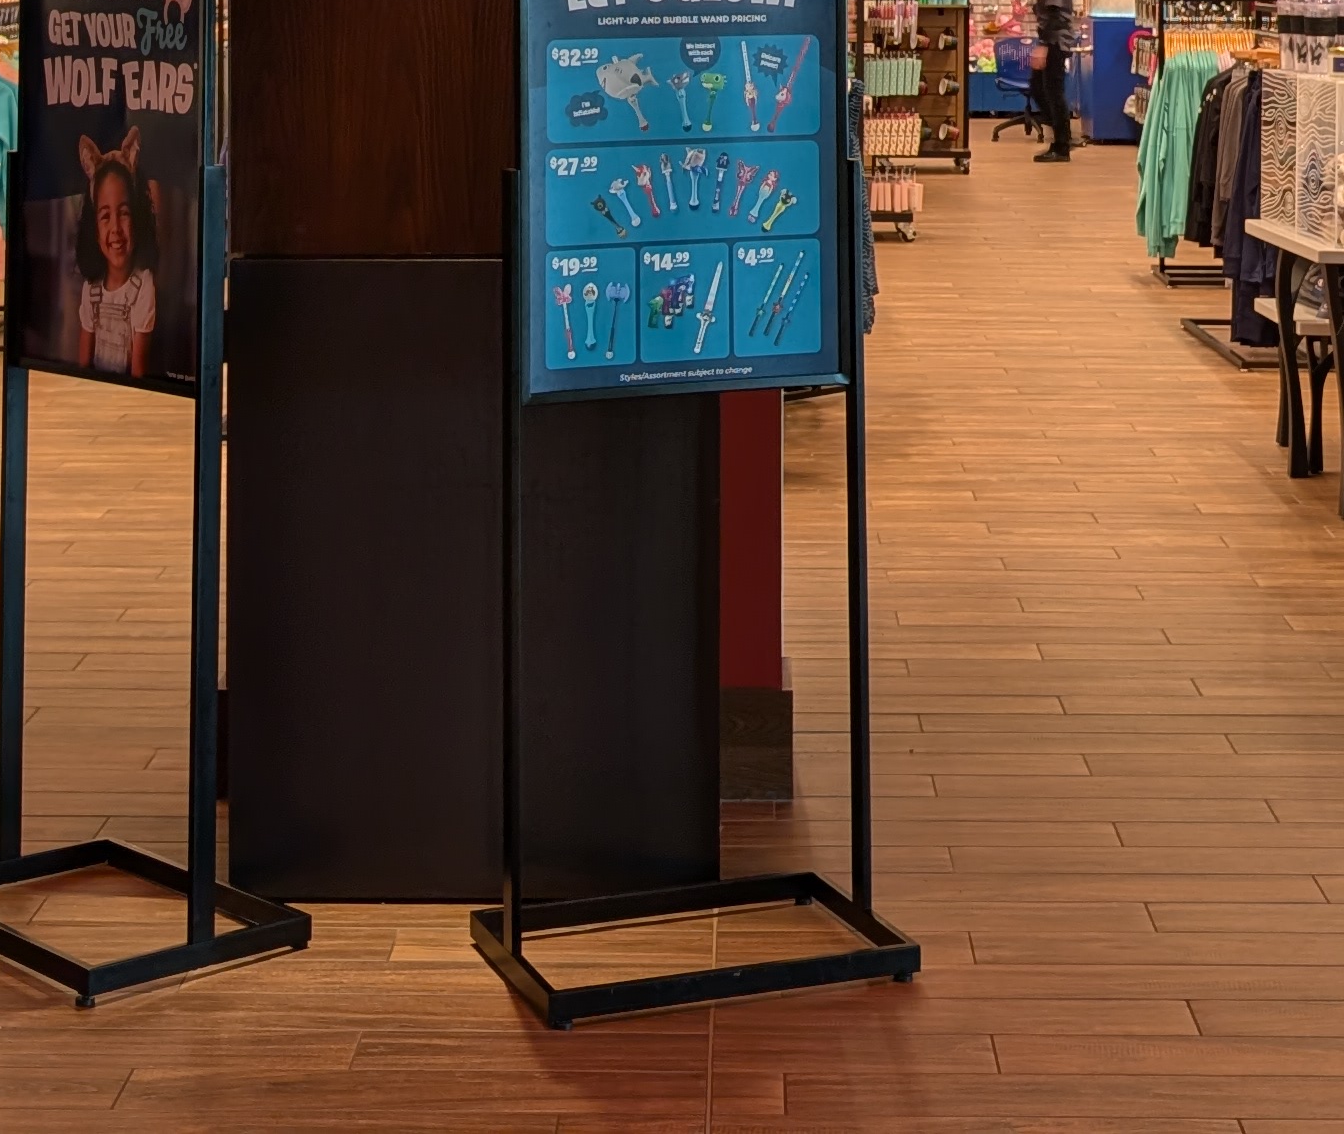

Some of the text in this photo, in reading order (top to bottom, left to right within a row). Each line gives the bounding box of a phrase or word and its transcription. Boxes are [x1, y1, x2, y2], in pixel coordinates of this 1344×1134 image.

[597, 14, 767, 26] LIGHT-UP AND BUBBLE WAND PRICING
[48, 7, 188, 56] GET YOUR Free
[551, 47, 599, 67] $32.99
[43, 55, 118, 108] WOLF
[549, 156, 598, 176] $27.99
[551, 255, 598, 277] $19.99
[643, 251, 690, 272] $14.99
[737, 246, 775, 266] $4.99
[619, 370, 686, 382] Styles/Assortment
[687, 368, 715, 378] subject
[724, 366, 753, 375] change
